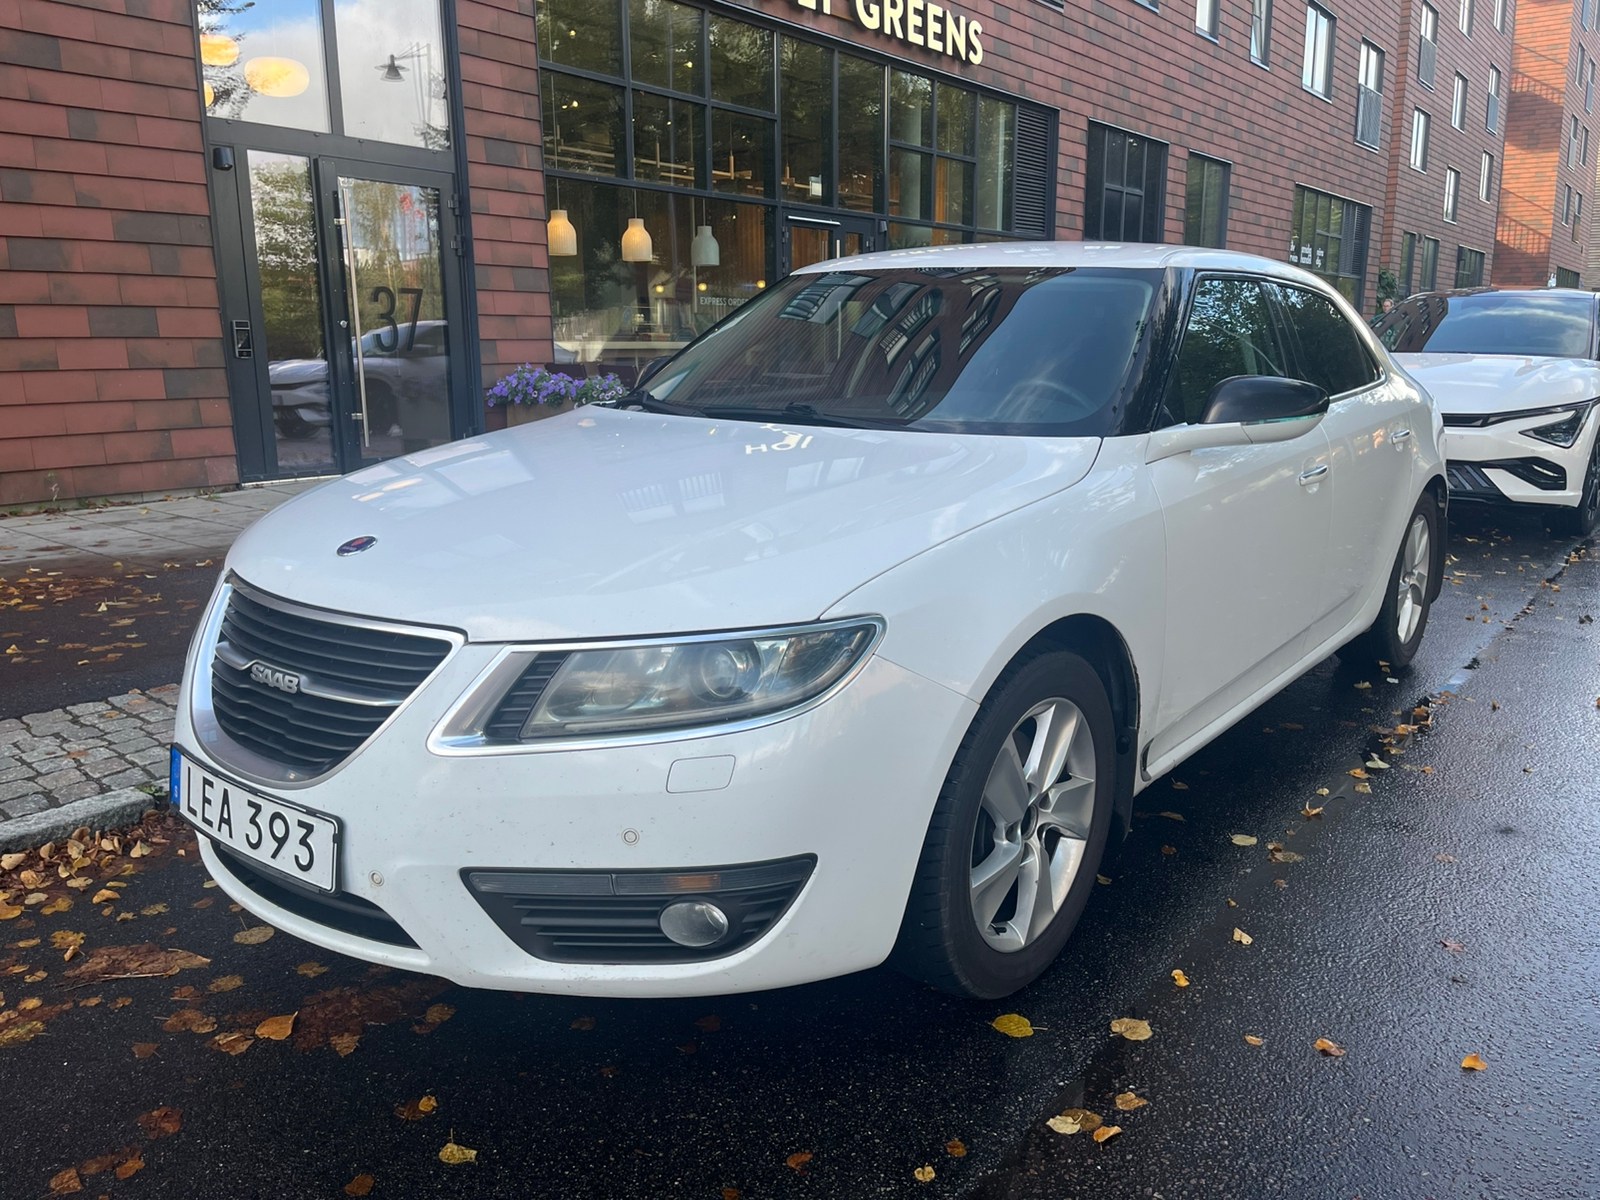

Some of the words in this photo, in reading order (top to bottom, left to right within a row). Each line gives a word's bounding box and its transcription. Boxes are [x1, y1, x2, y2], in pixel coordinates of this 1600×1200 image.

[856, 0, 983, 65] GREENS
[371, 286, 423, 352] 37
[700, 296, 726, 306] EXPRESS
[250, 663, 299, 694] SAAB
[187, 766, 233, 839] LEA
[245, 799, 315, 872] 393
